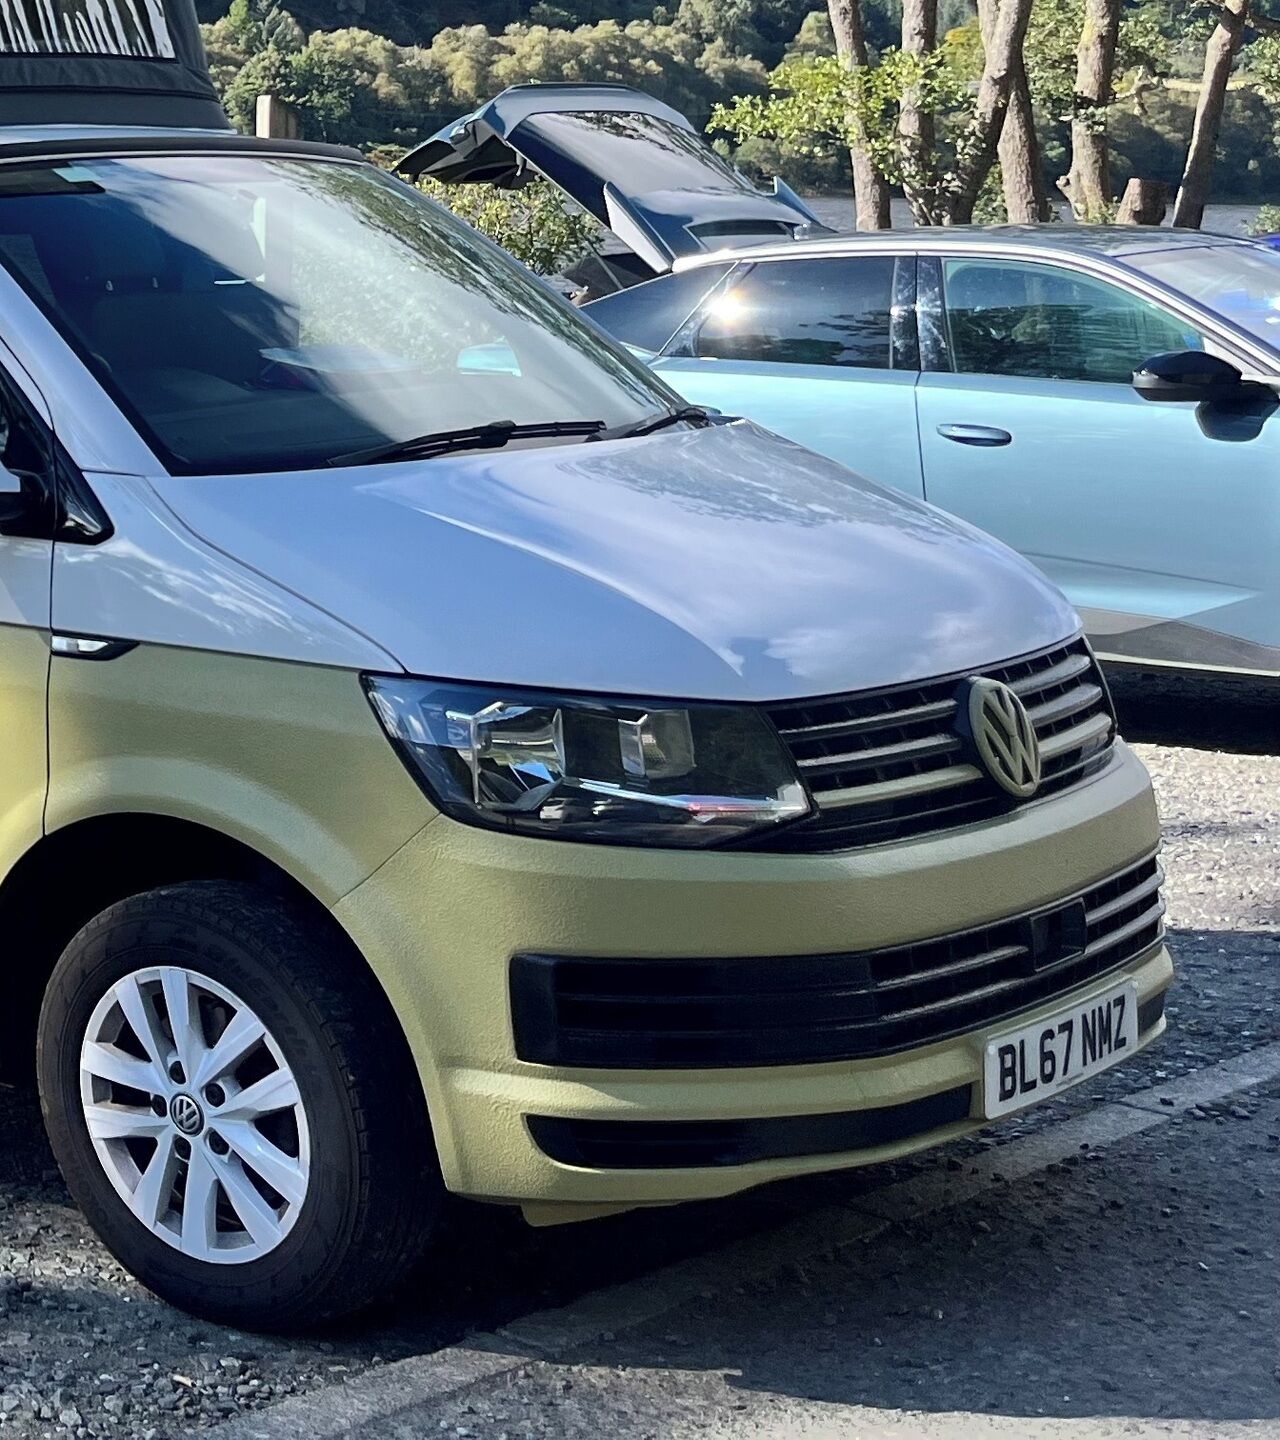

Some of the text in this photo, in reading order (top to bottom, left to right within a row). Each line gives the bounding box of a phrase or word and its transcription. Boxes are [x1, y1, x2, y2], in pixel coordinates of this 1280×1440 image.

[974, 679, 1040, 793] VW
[998, 994, 1127, 1102] BL67 NMZ
